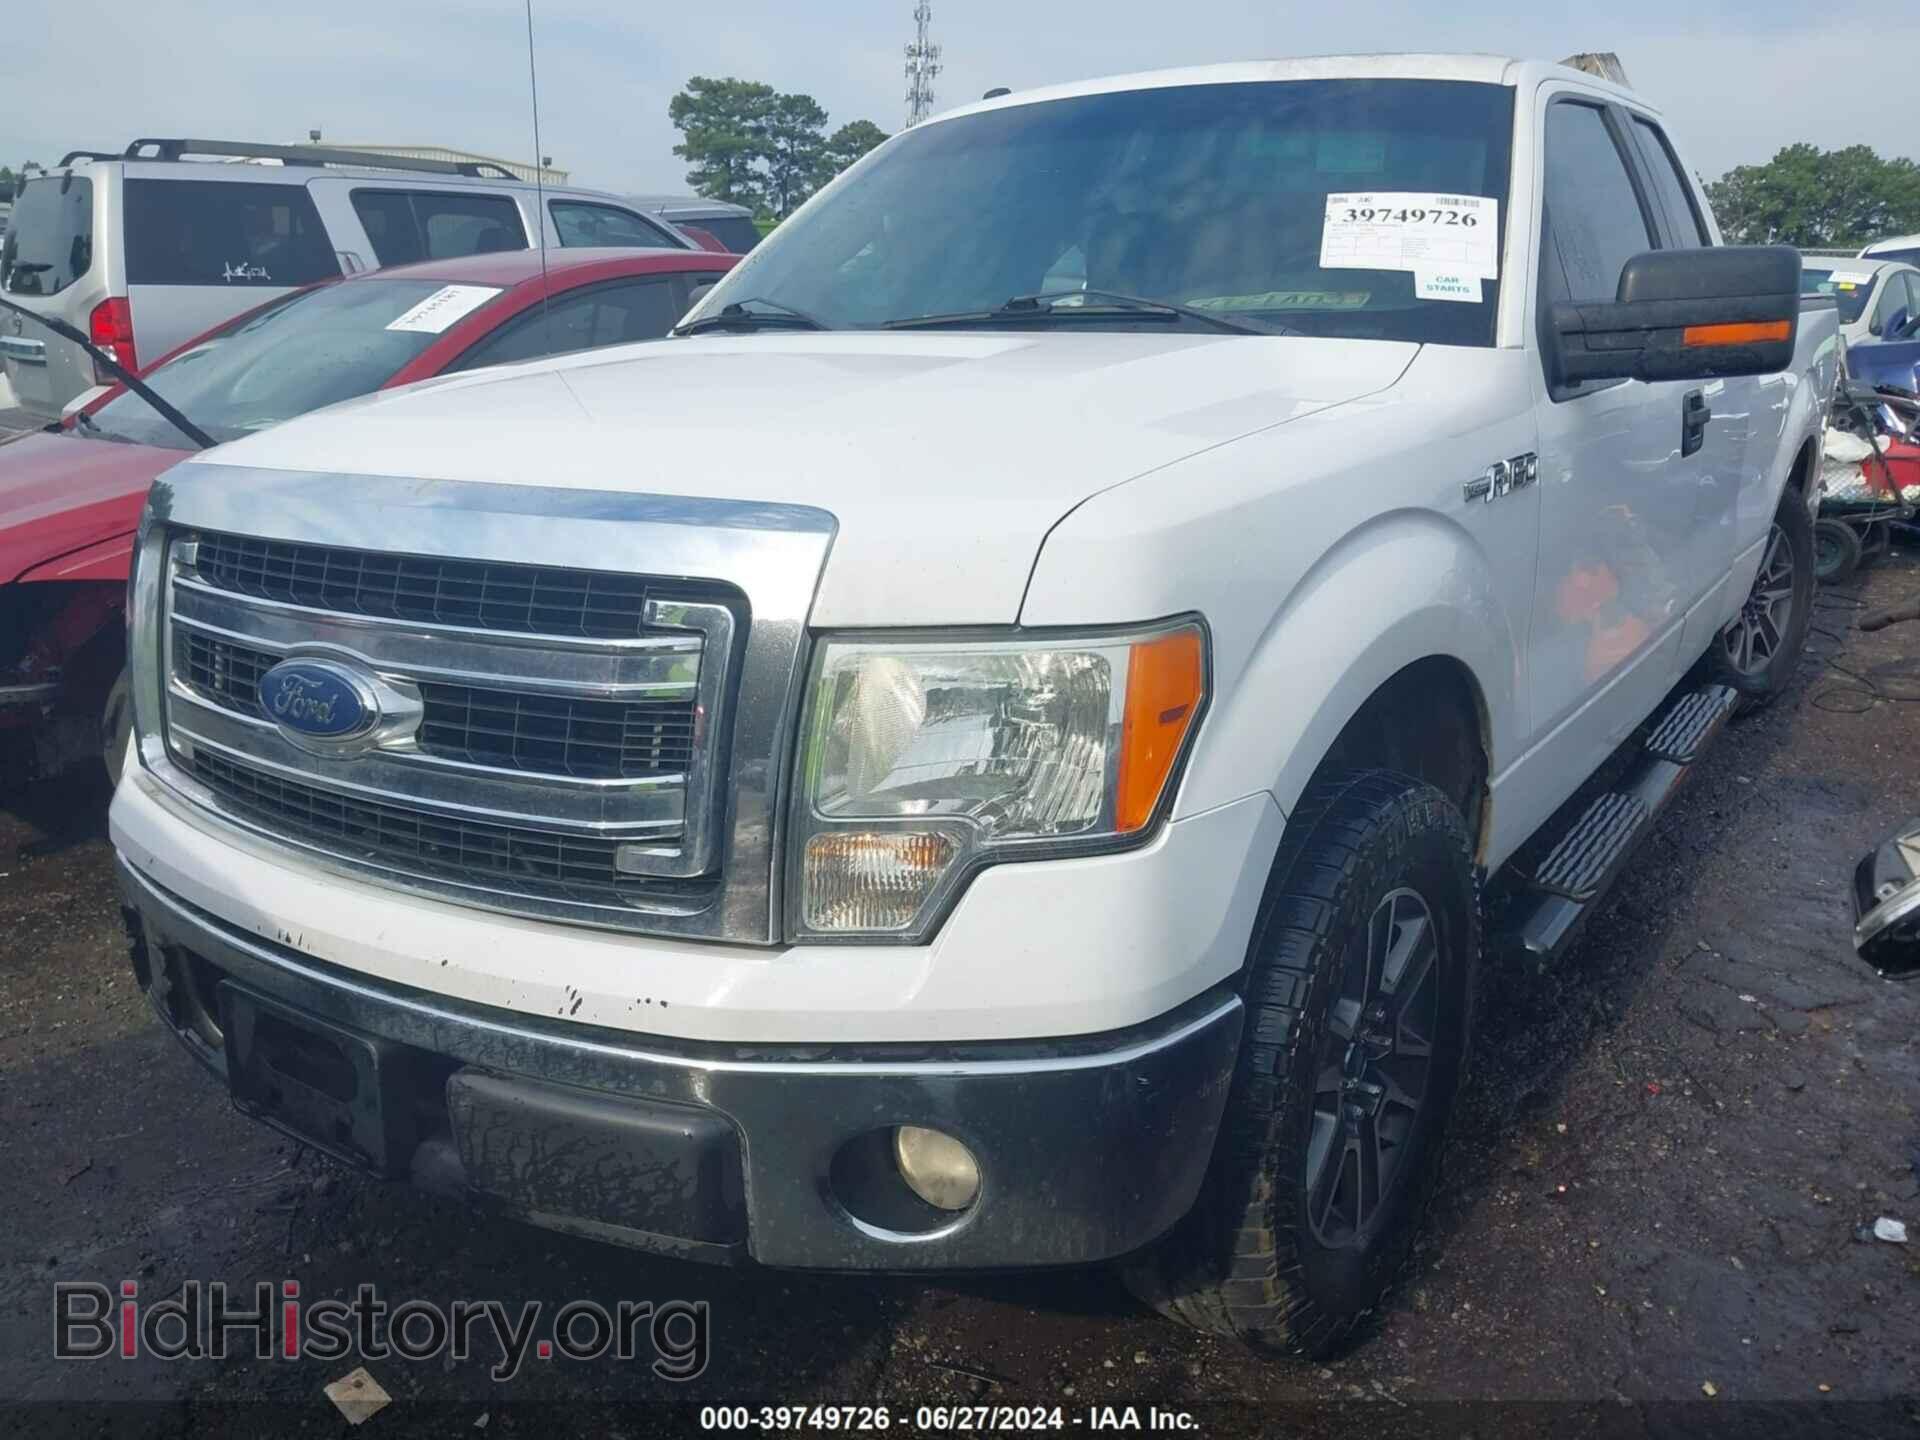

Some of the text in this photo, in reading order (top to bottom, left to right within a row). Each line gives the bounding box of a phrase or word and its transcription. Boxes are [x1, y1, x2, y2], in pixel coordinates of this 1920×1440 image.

[1343, 208, 1477, 227] 39749726
[1435, 275, 1460, 284] CAR
[1425, 284, 1471, 294] STARTS
[273, 673, 339, 725] Ford
